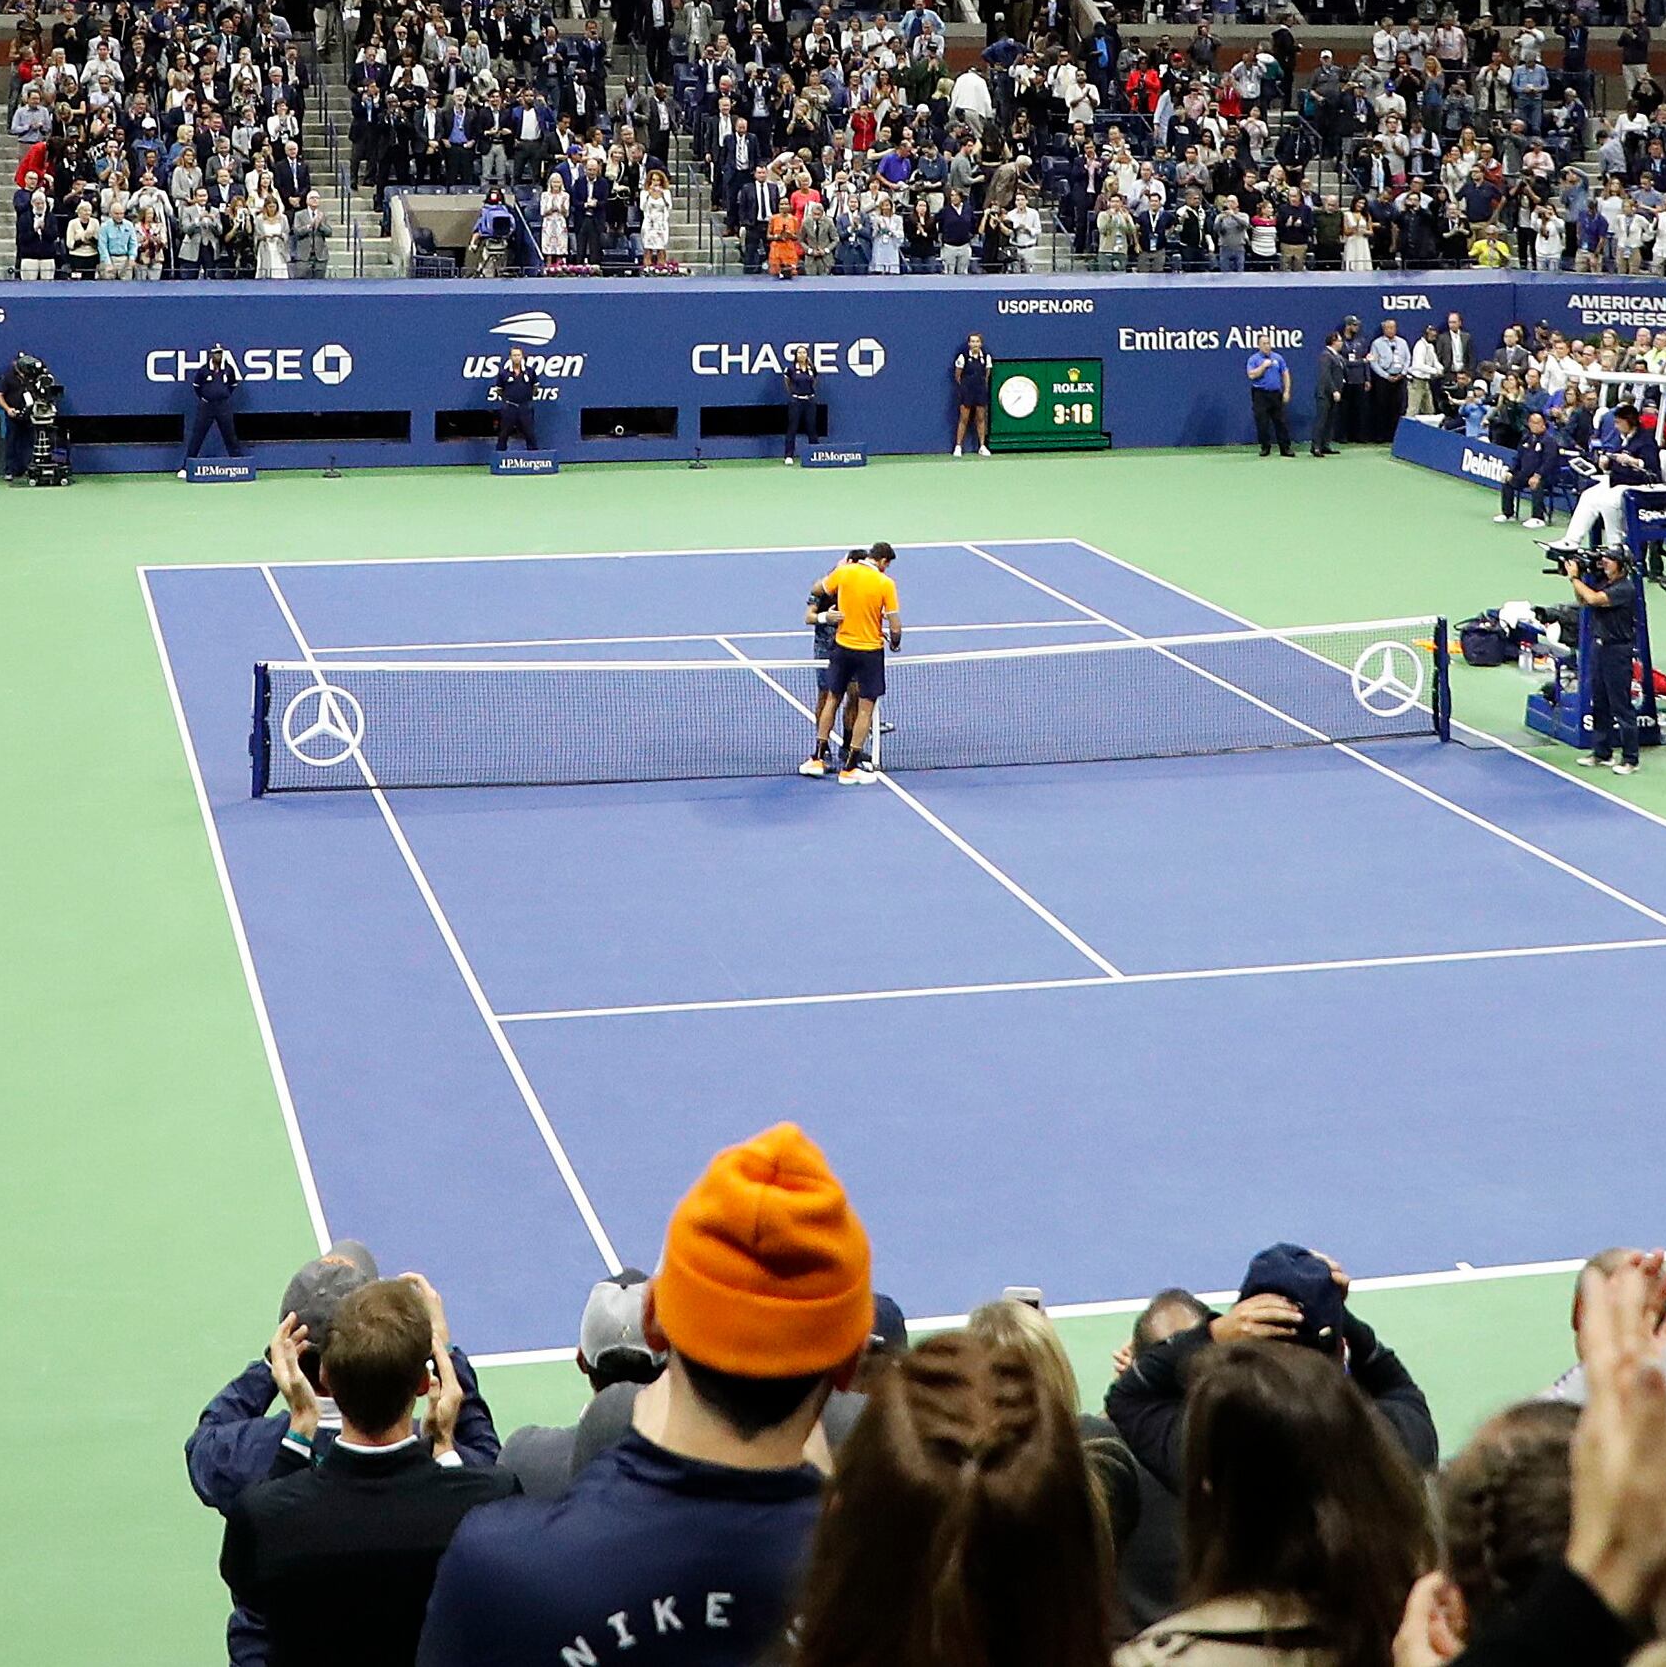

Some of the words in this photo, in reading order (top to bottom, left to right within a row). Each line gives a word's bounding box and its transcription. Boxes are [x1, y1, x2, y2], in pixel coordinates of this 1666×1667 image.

[998, 299, 1094, 314] USOPEN.ORG
[1382, 295, 1432, 310] USTA
[1118, 326, 1219, 351] Emirates
[462, 355, 501, 378] us
[1053, 383, 1095, 394] ROLEX
[499, 458, 552, 471] J.P.Morgan
[811, 451, 862, 463] J.P.Morgan
[194, 465, 249, 478] J.P.Morgan
[560, 1591, 734, 1667] NIKE
